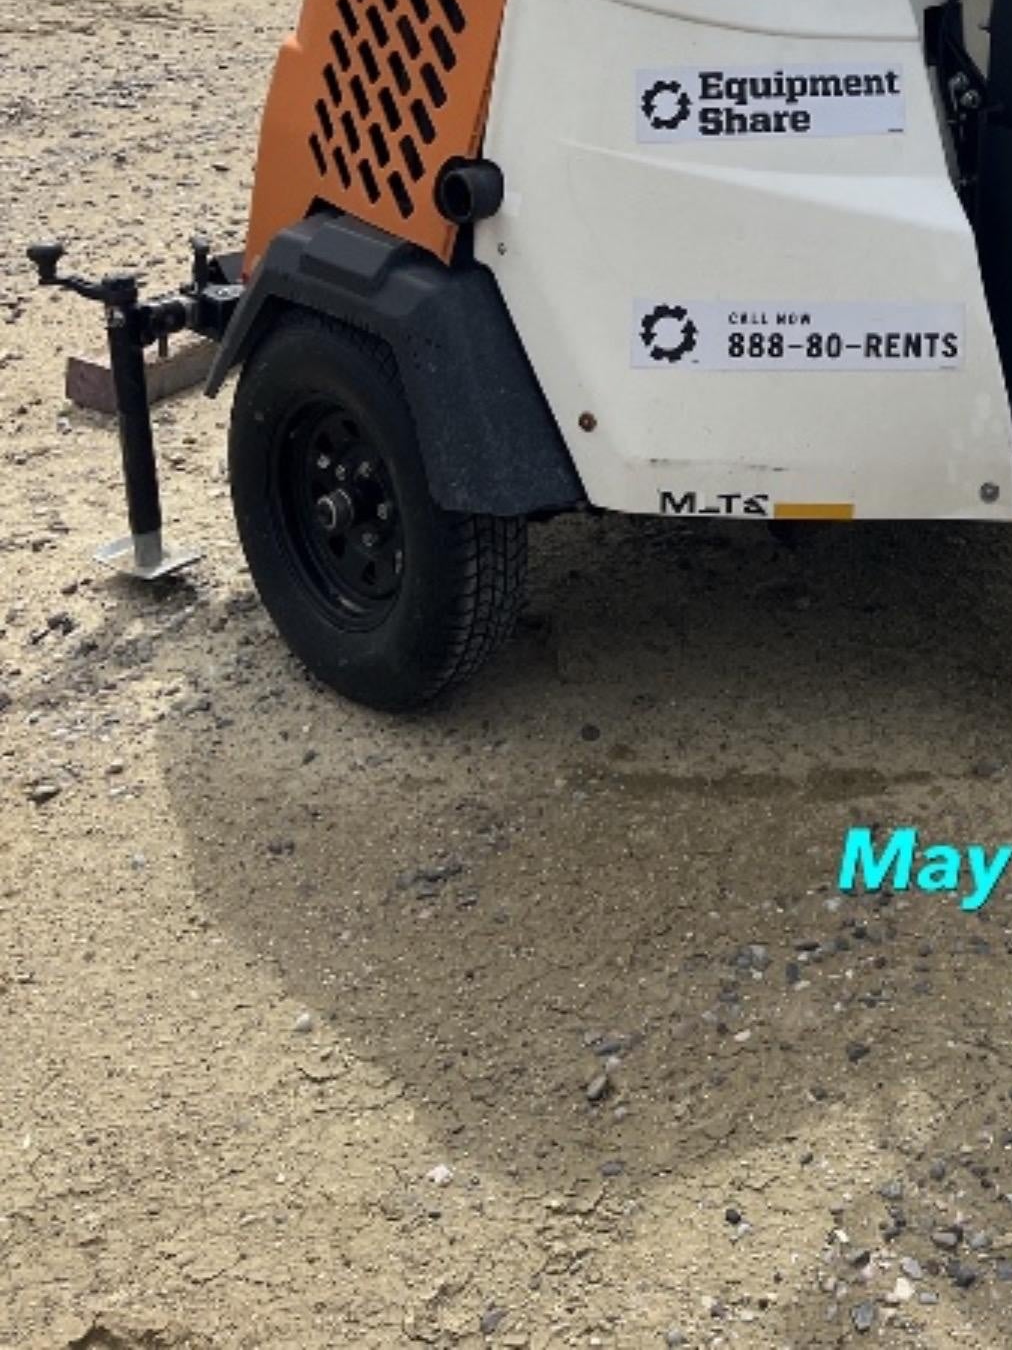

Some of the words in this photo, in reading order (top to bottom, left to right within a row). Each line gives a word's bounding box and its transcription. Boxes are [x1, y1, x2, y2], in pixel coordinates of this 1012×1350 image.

[698, 70, 901, 105] Equipment
[698, 107, 811, 136] Share
[728, 312, 768, 325] CALL
[776, 312, 811, 325] NOW
[728, 332, 959, 358] 888-80-RENTS
